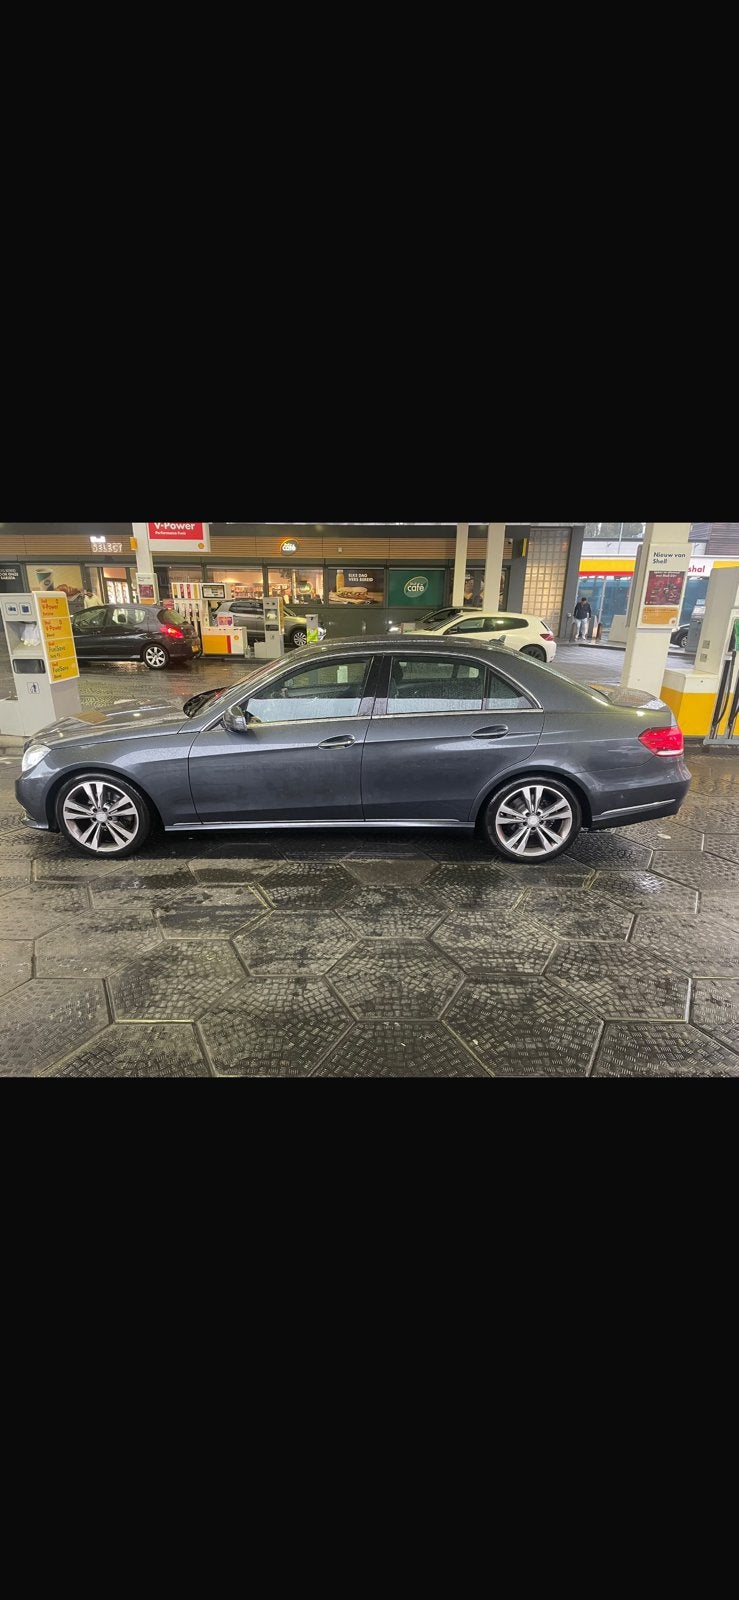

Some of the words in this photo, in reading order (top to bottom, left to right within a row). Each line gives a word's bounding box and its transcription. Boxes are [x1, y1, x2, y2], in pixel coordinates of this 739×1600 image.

[154, 522, 195, 530] V-Power
[92, 542, 122, 553] SELECT
[408, 583, 425, 592] café
